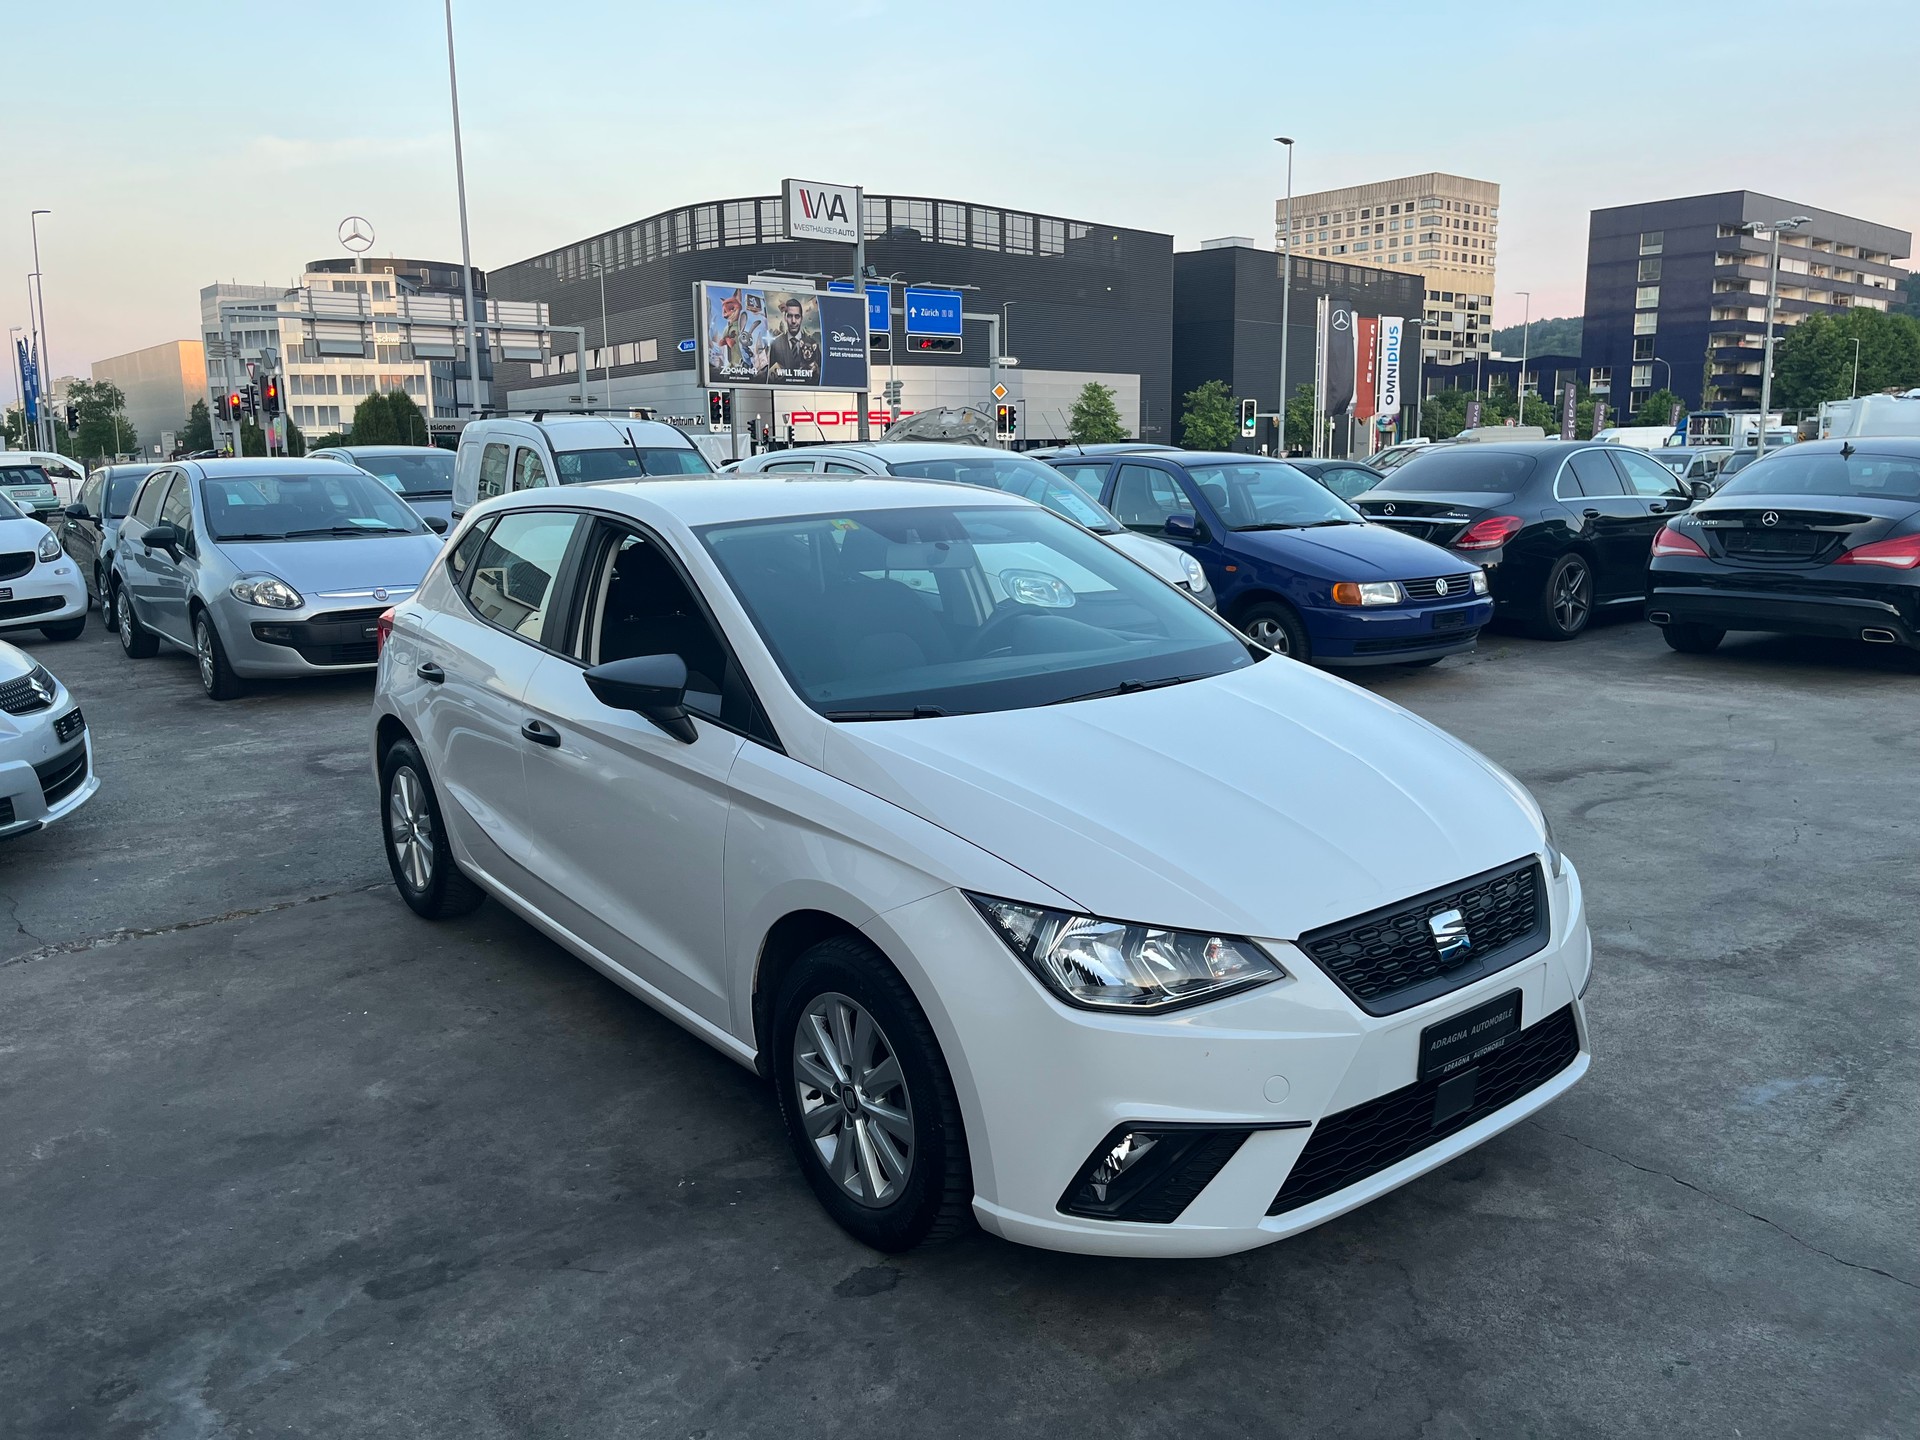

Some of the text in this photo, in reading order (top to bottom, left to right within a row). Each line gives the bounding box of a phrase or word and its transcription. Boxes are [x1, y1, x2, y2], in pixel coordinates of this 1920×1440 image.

[920, 308, 939, 317] Zürich
[720, 365, 759, 375] ZOOMANIA
[776, 368, 814, 378] WILL TRENT
[1430, 1008, 1513, 1051] ADRAGNA AUTOMOBILE
[1443, 1039, 1506, 1073] ADRAGNA AUTOMOBILE
